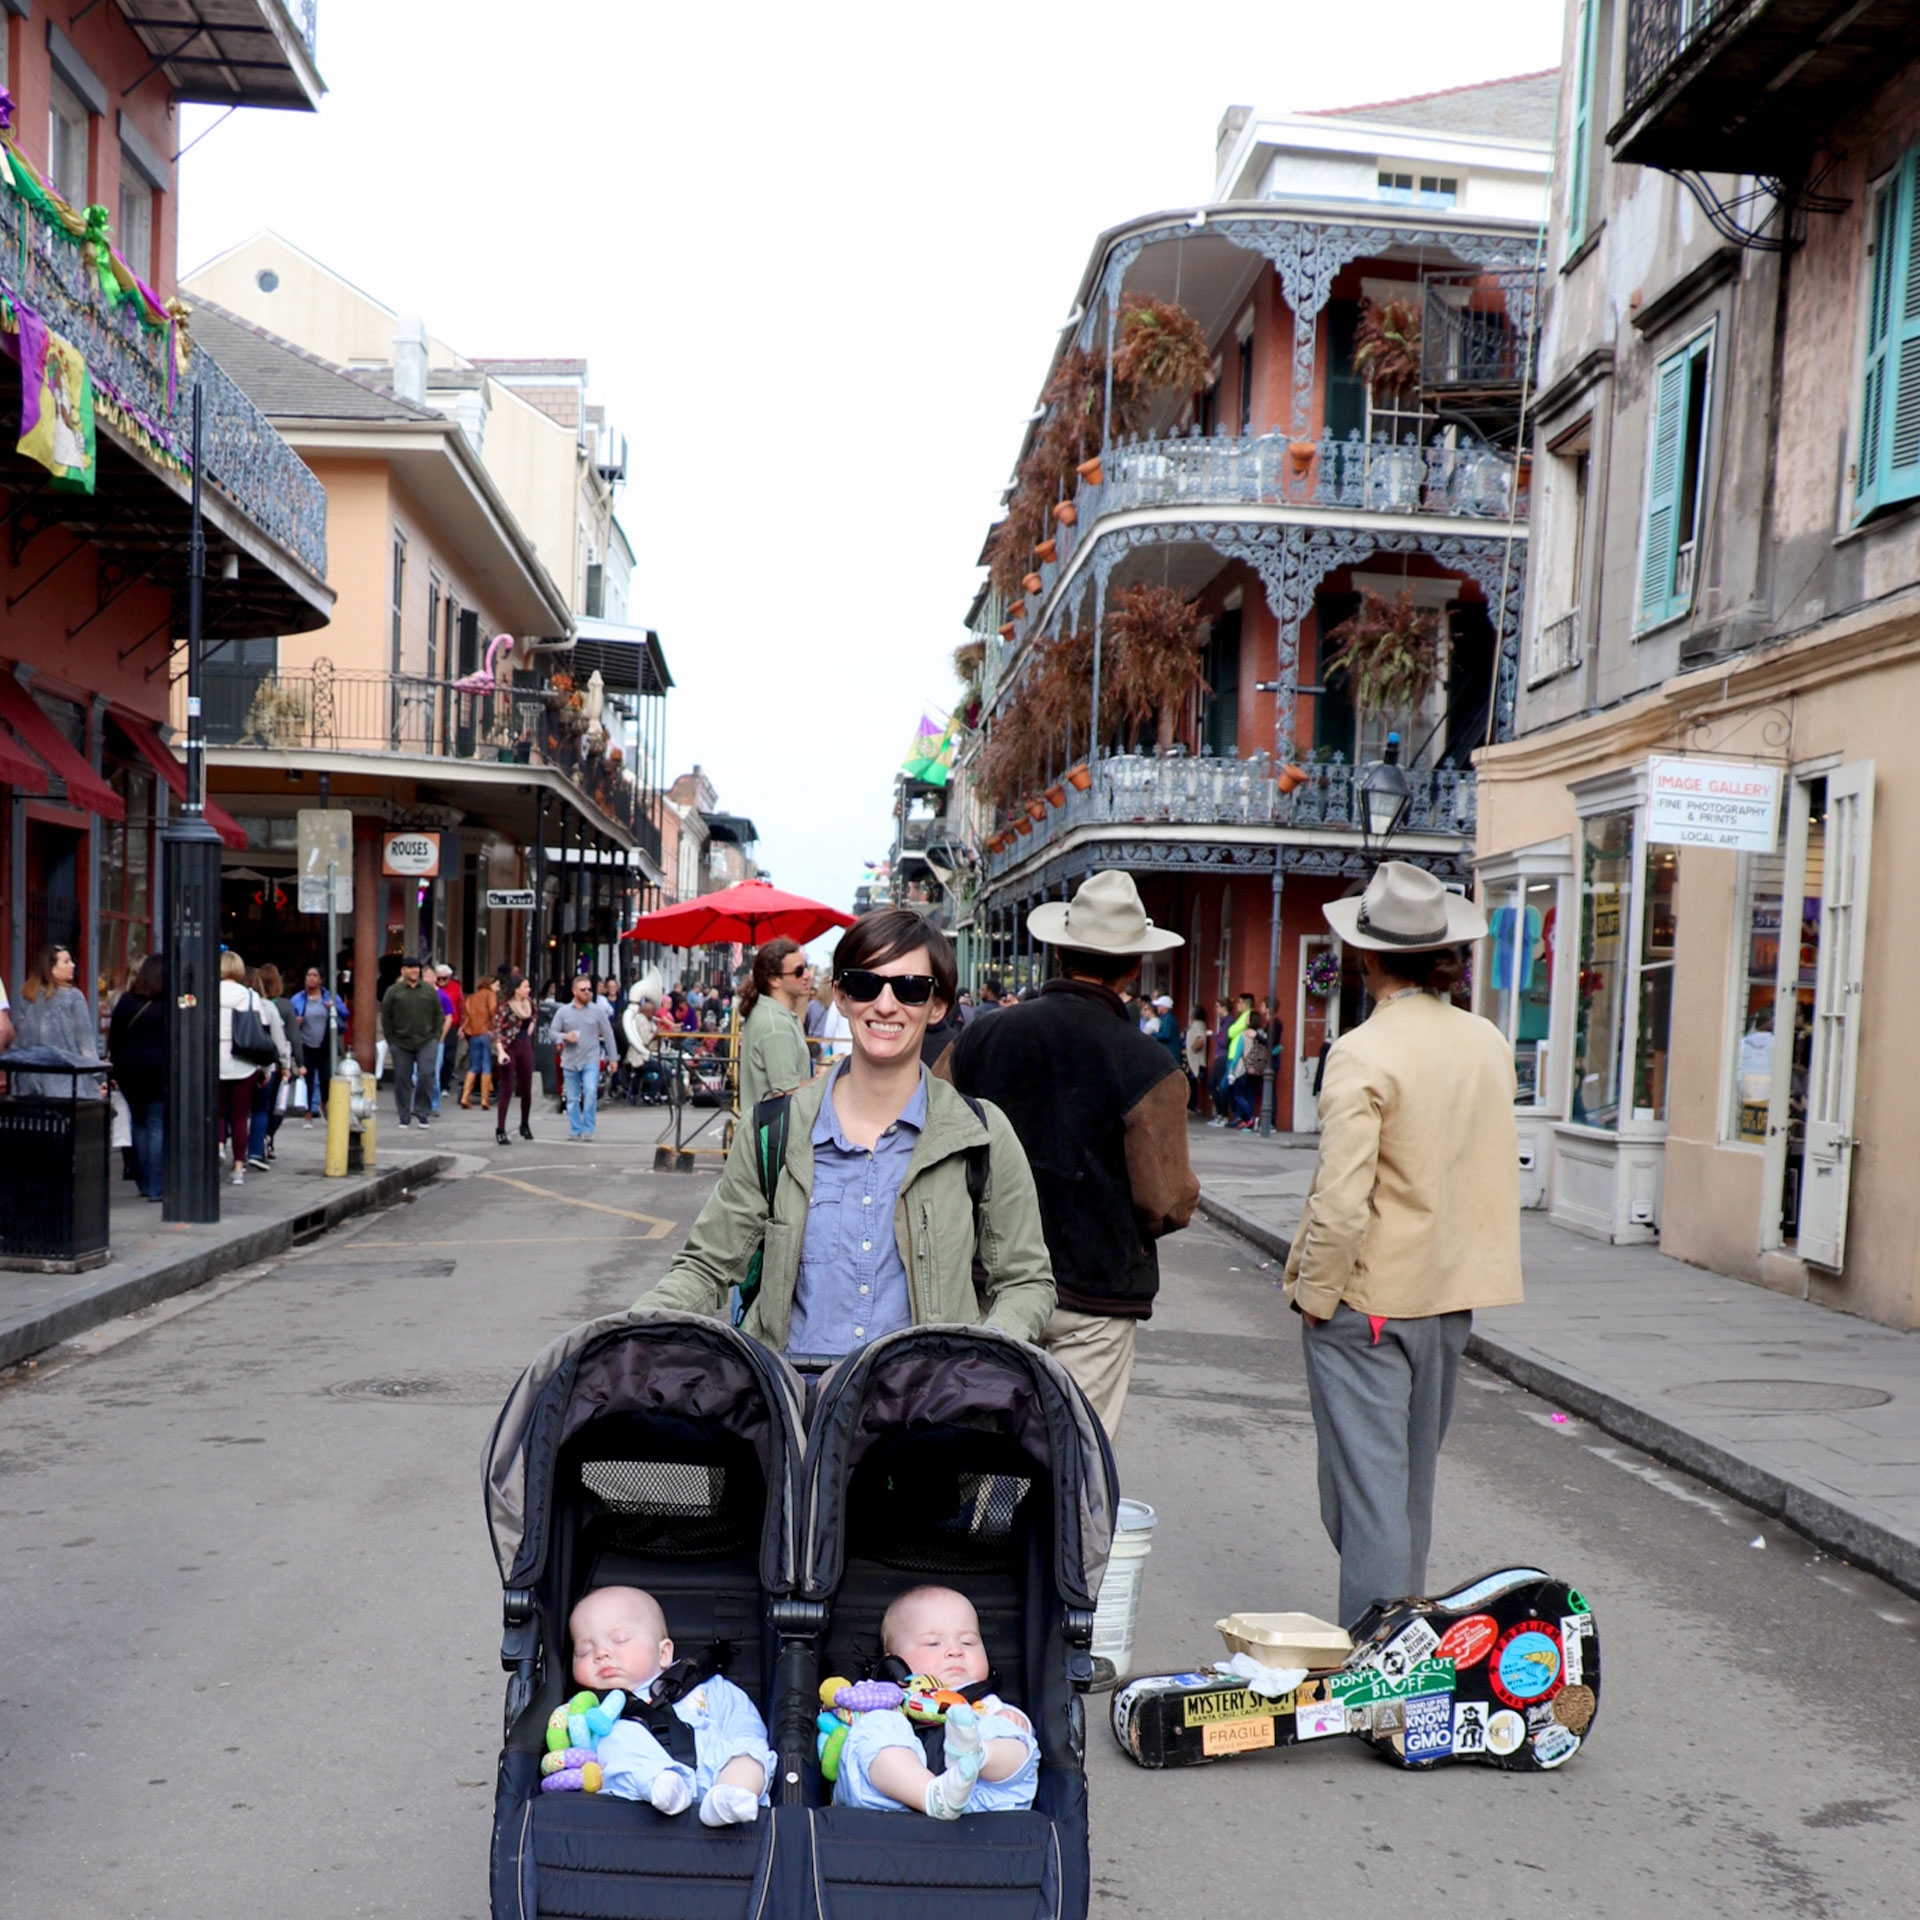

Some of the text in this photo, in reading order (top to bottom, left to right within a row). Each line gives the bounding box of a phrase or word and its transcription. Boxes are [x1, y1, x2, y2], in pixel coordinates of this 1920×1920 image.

[1657, 775, 1771, 797] IMAGE GALLERY
[1659, 798, 1767, 816] FINE PHOTOGRAPHY
[1687, 812, 1738, 825] & PRINTS
[1681, 831, 1740, 845] LOCAL ART
[391, 841, 429, 856] ROUSES
[505, 895, 533, 905] Peter
[1400, 1625, 1421, 1645] MILLS
[1403, 1631, 1429, 1654] RECORD
[1408, 1637, 1437, 1664] COMPANY
[1330, 1658, 1452, 1690] DON'T CUT
[1187, 1690, 1247, 1716] MYSTERY
[1406, 1710, 1450, 1728] KNOW
[1208, 1723, 1270, 1744] FRAGILE
[1407, 1728, 1452, 1752] GMO
